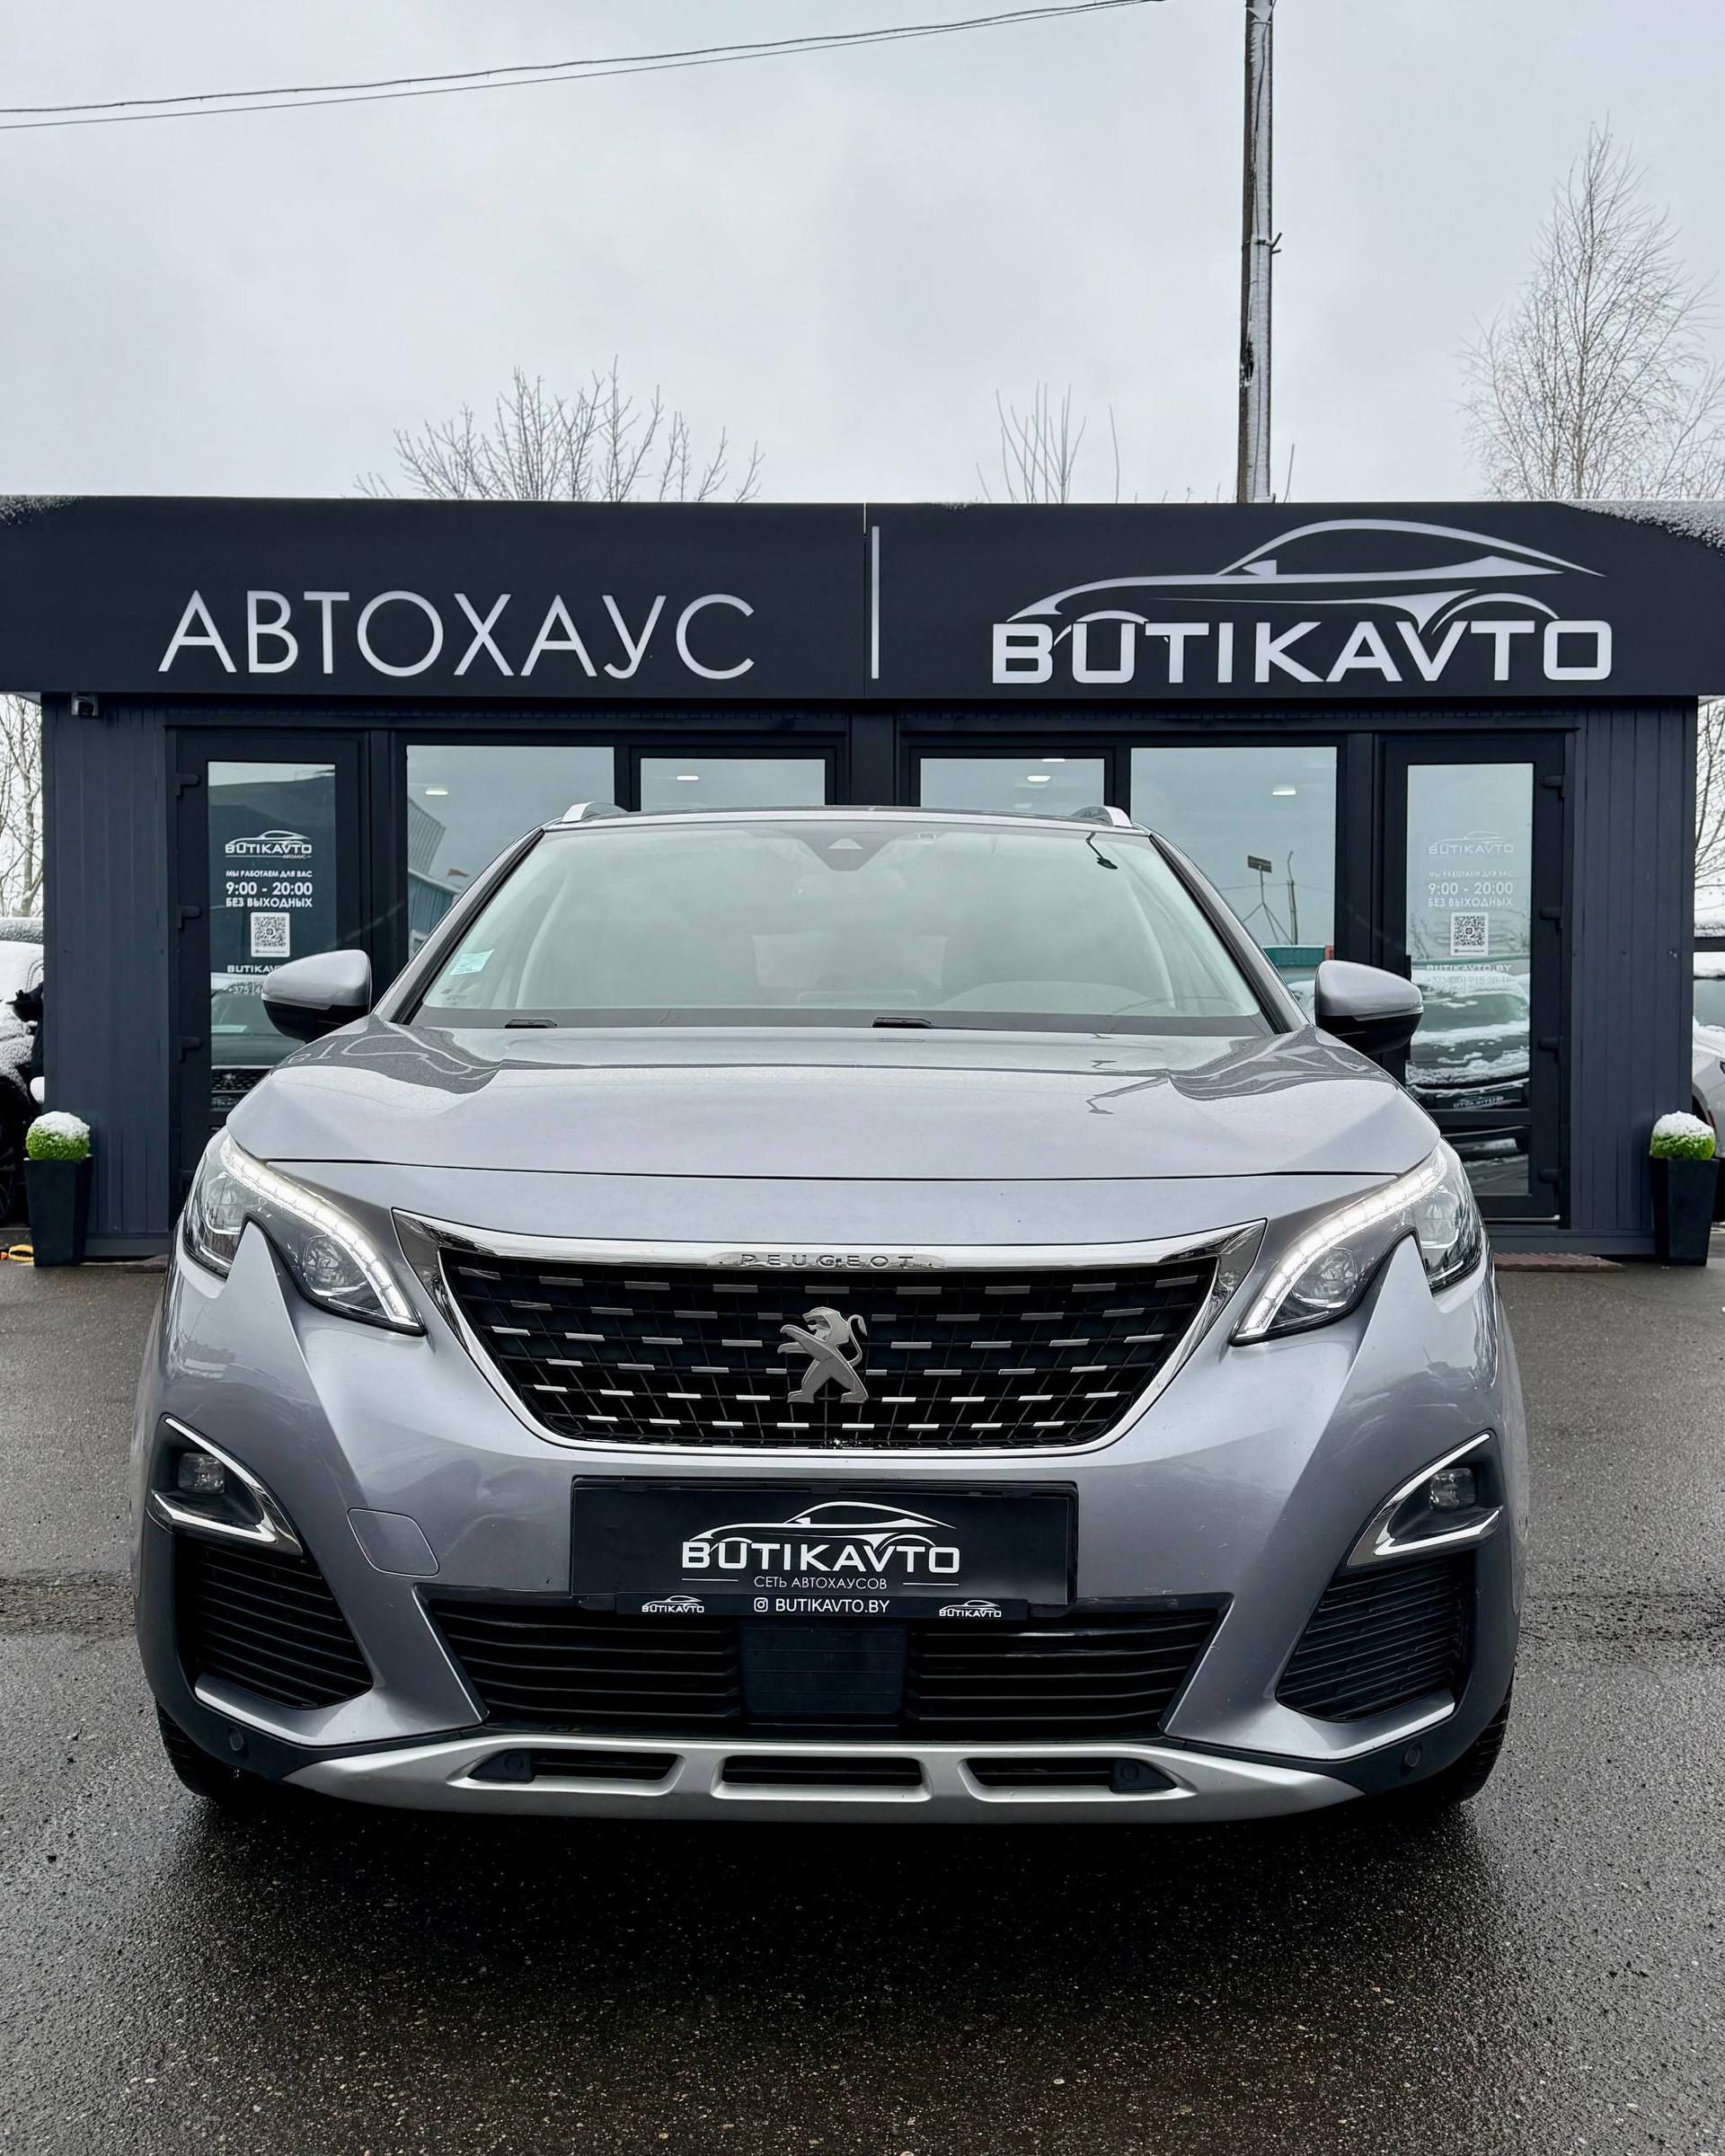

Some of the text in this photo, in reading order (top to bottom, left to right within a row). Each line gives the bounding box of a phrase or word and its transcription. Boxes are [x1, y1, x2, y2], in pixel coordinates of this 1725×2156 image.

[157, 589, 755, 680] АВТОХАУС
[992, 620, 1614, 685] BUTIKAVTO
[225, 843, 313, 854] BUTIKAVTO
[1429, 844, 1514, 854] BUTIKAVTO
[279, 870, 296, 879] ДЛЯ
[226, 882, 257, 895] 9:00
[272, 882, 313, 895] 20:00
[1429, 882, 1458, 895] 9:00
[1473, 882, 1513, 895] 20:00
[226, 898, 313, 908] БЕЗ ВЫХОДНЫХ
[1429, 898, 1513, 907] БЕЗ ВЫХОДНЫХ
[739, 1254, 914, 1268] PEUGEOT
[682, 1541, 960, 1574] BUTIKAVTO
[754, 1576, 887, 1590] СЕТЬ АВТОХАУСОВ
[641, 1604, 704, 1613] BUTIKAVTO
[775, 1598, 890, 1613] BUTIKAVTO.BY
[939, 1608, 1002, 1618] BUTIKAVTO
